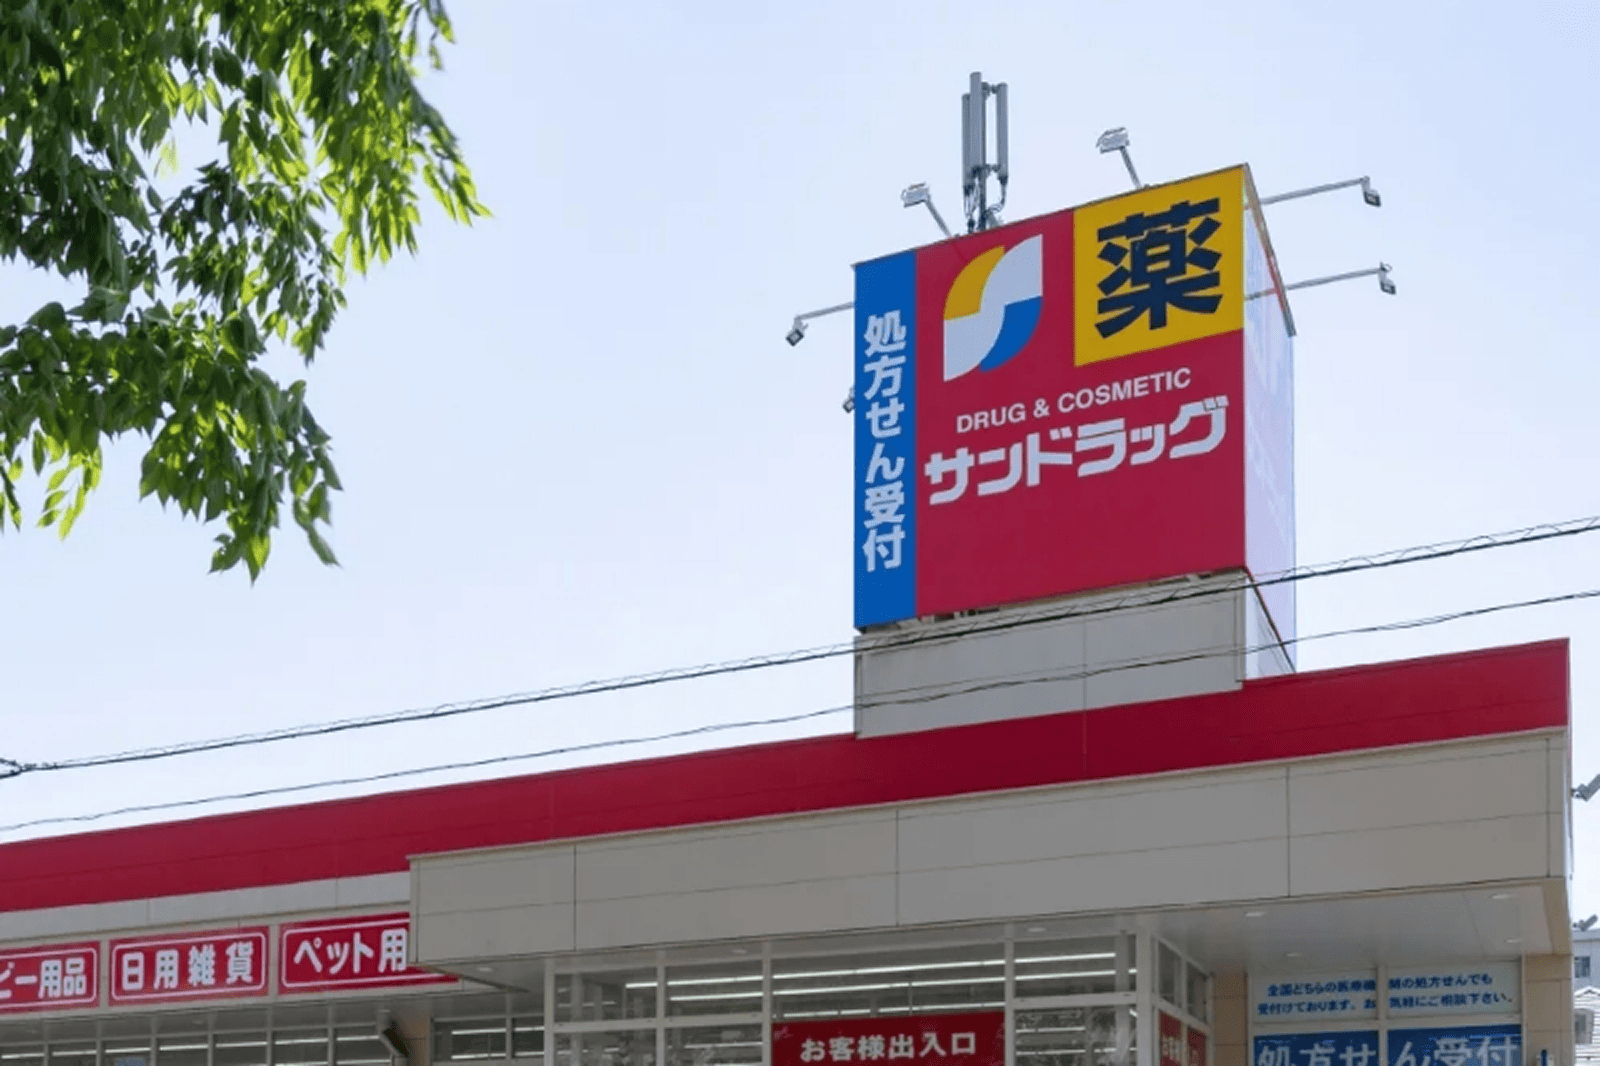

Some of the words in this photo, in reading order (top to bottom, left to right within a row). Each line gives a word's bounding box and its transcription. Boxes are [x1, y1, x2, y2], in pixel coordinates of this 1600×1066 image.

[1095, 197, 1223, 338] 薬
[956, 402, 1026, 434] DRUG
[1033, 398, 1050, 418] &
[1057, 367, 1192, 413] COSMETIC
[862, 310, 906, 572] 処方せん受付
[924, 395, 1229, 504] サンドラッグ
[121, 941, 254, 991] 日用雑貨
[293, 928, 408, 975] ペット用
[800, 1031, 977, 1063] お客様出入口
